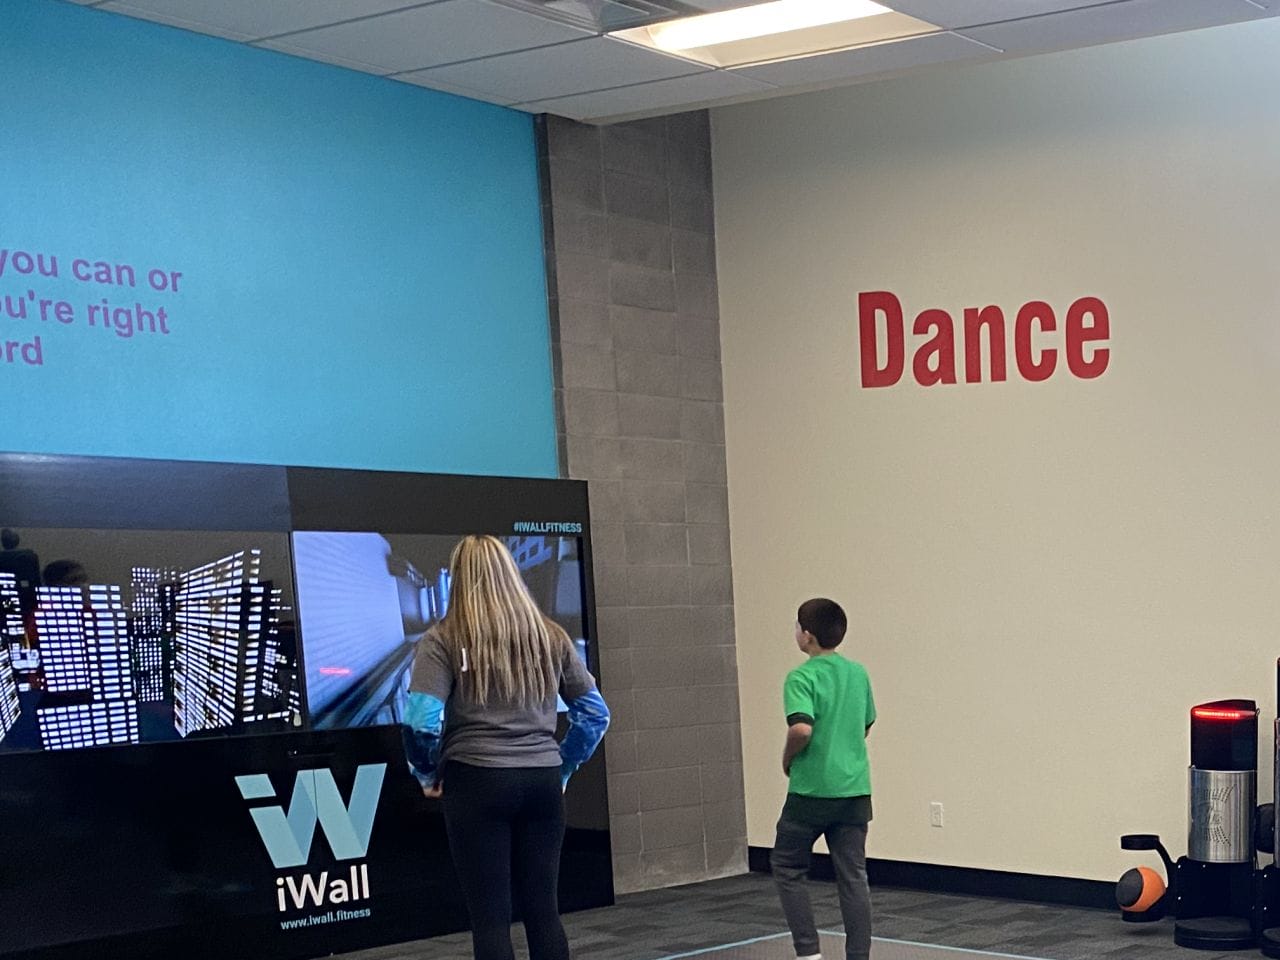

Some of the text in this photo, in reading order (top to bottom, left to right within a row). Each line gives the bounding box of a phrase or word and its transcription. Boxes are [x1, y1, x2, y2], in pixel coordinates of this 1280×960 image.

[72, 258, 136, 288] can
[148, 268, 183, 293] or
[0, 289, 170, 338] u're right
[0, 335, 44, 366] rd
[858, 290, 1110, 389] Dance
[276, 863, 371, 913] iWall
[280, 907, 372, 931] www.iwall.fitness
